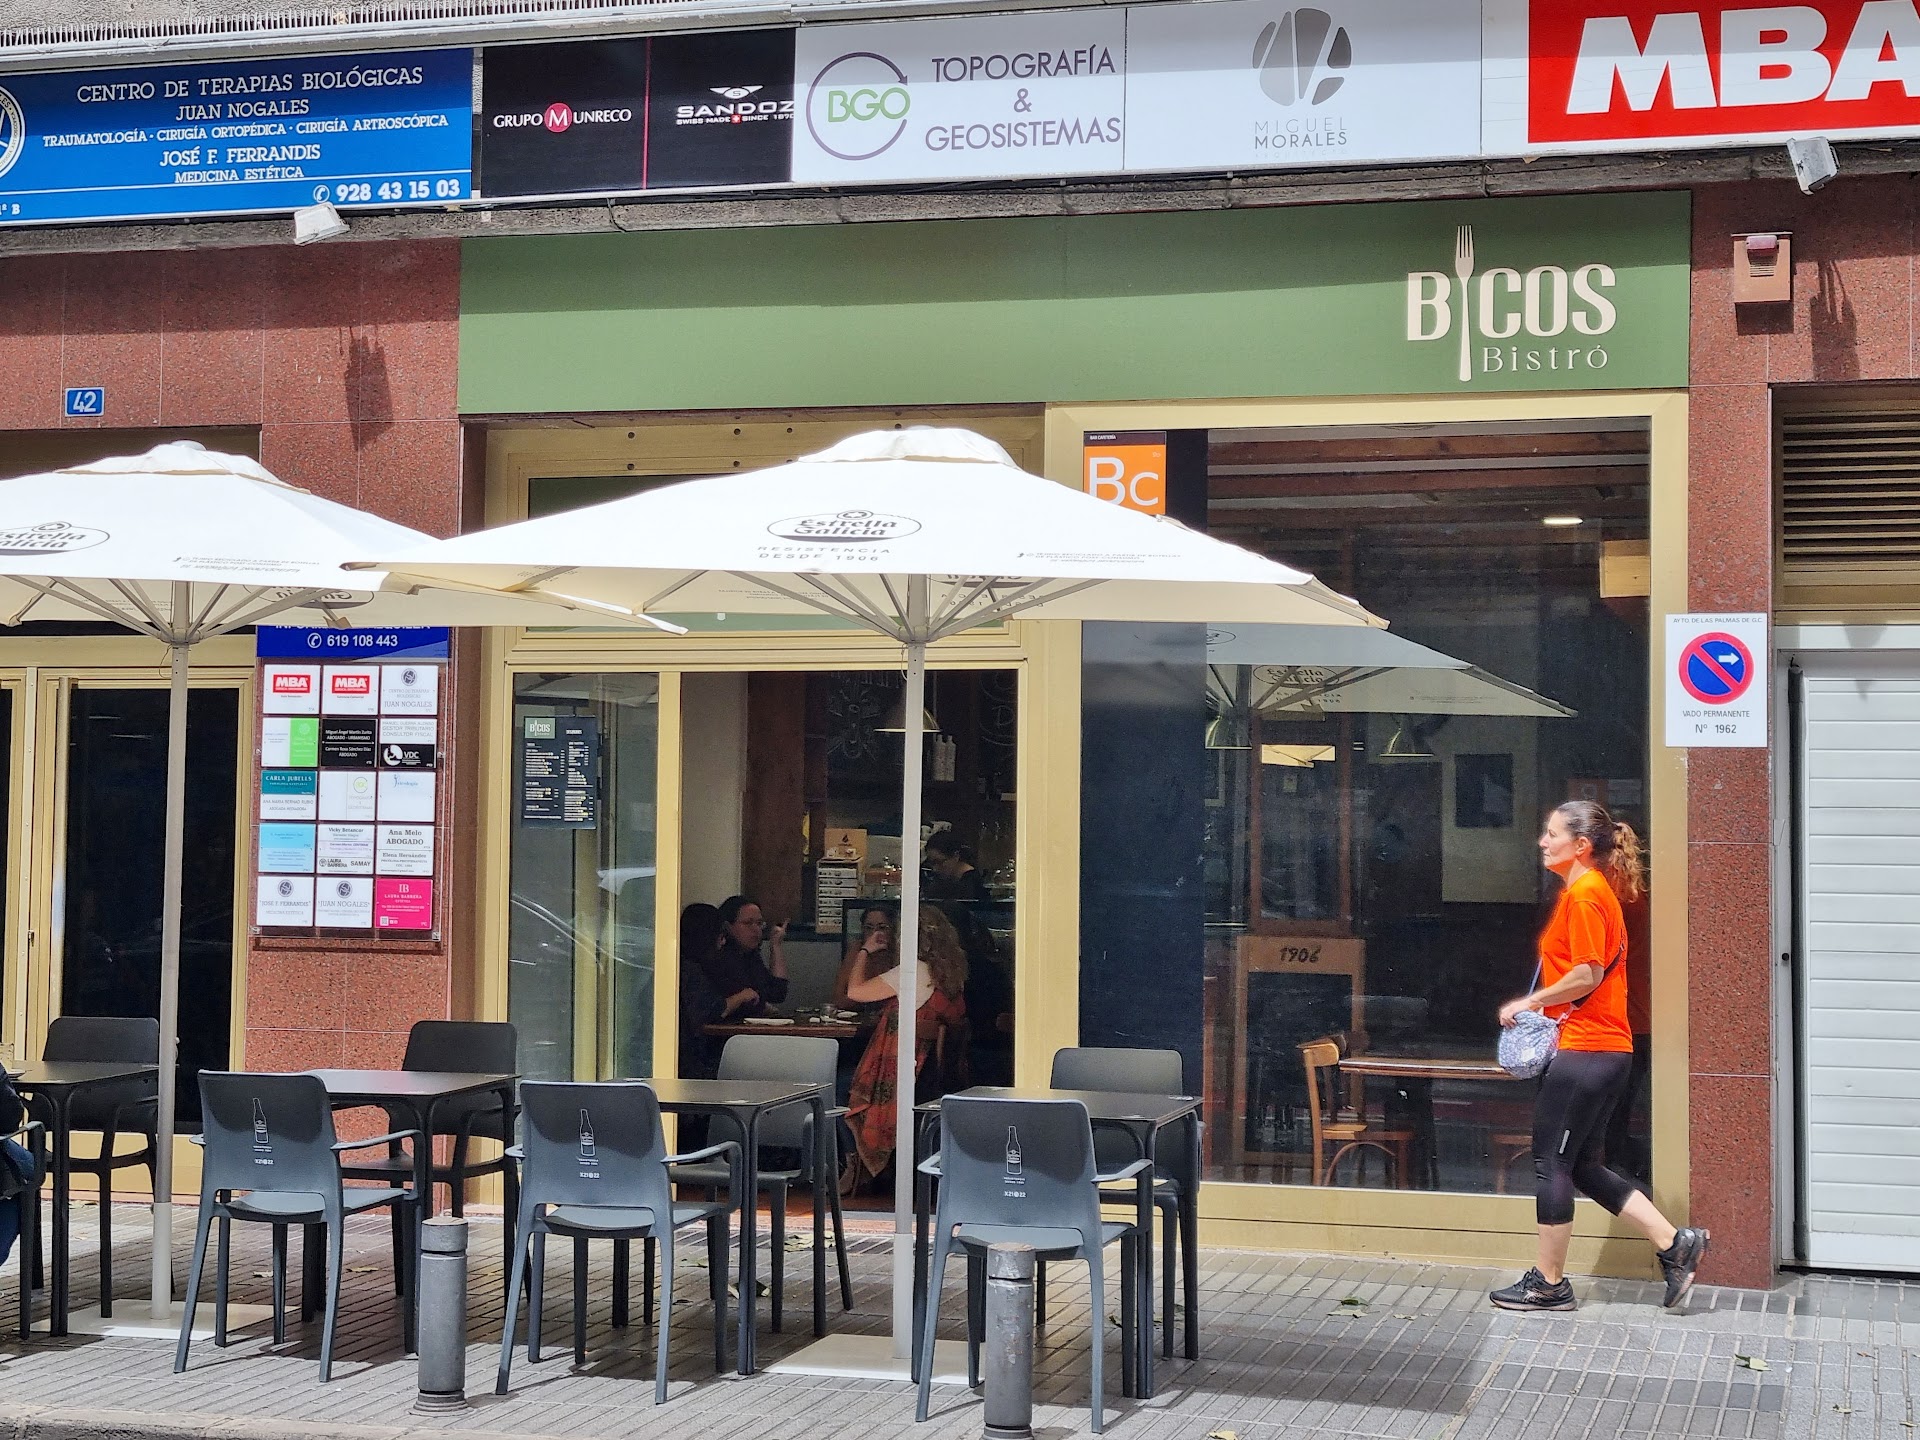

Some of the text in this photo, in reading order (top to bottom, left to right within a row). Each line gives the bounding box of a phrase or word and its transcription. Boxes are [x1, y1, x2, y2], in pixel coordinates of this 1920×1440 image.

[931, 45, 1116, 82] TOPOGRAFÍA
[1566, 0, 1920, 114] MBA
[77, 66, 422, 102] CENTRO DE TERAPIAS BIOLÓGICAS
[827, 86, 911, 124] BGO
[1014, 88, 1032, 112] &
[176, 99, 309, 120] JUAN NOGALES
[494, 109, 631, 127] GRUPO MUNRECO
[677, 101, 795, 118] SANDOZ
[43, 112, 448, 146] TRAUMATOLOGÍA CIRUGÍA ORTOPÉDICA CIRUGÍA ARTROSCÓPICA
[925, 117, 1122, 151] GEOSISTEMAS
[1255, 117, 1347, 133] MIGUEL
[1255, 131, 1347, 149] MORALES
[160, 144, 320, 166] JOSÉ F. FERRANDIS
[175, 165, 304, 183] MEDICINA ESTÉTICA
[337, 179, 460, 201] 928 43 15 03
[11, 204, 20, 215] B
[1483, 345, 1607, 372] Bistró
[73, 391, 97, 412] 42
[1089, 457, 1159, 506] Bc
[794, 527, 886, 535] Galicia
[798, 519, 897, 528] Estrella
[0, 532, 86, 540] strella
[0, 540, 68, 548] alicia
[327, 635, 398, 646] 619 108 443
[275, 677, 308, 688] MBA
[335, 677, 367, 688] MBA
[1695, 724, 1737, 733] Nº 1962
[1280, 946, 1321, 963] 1906
